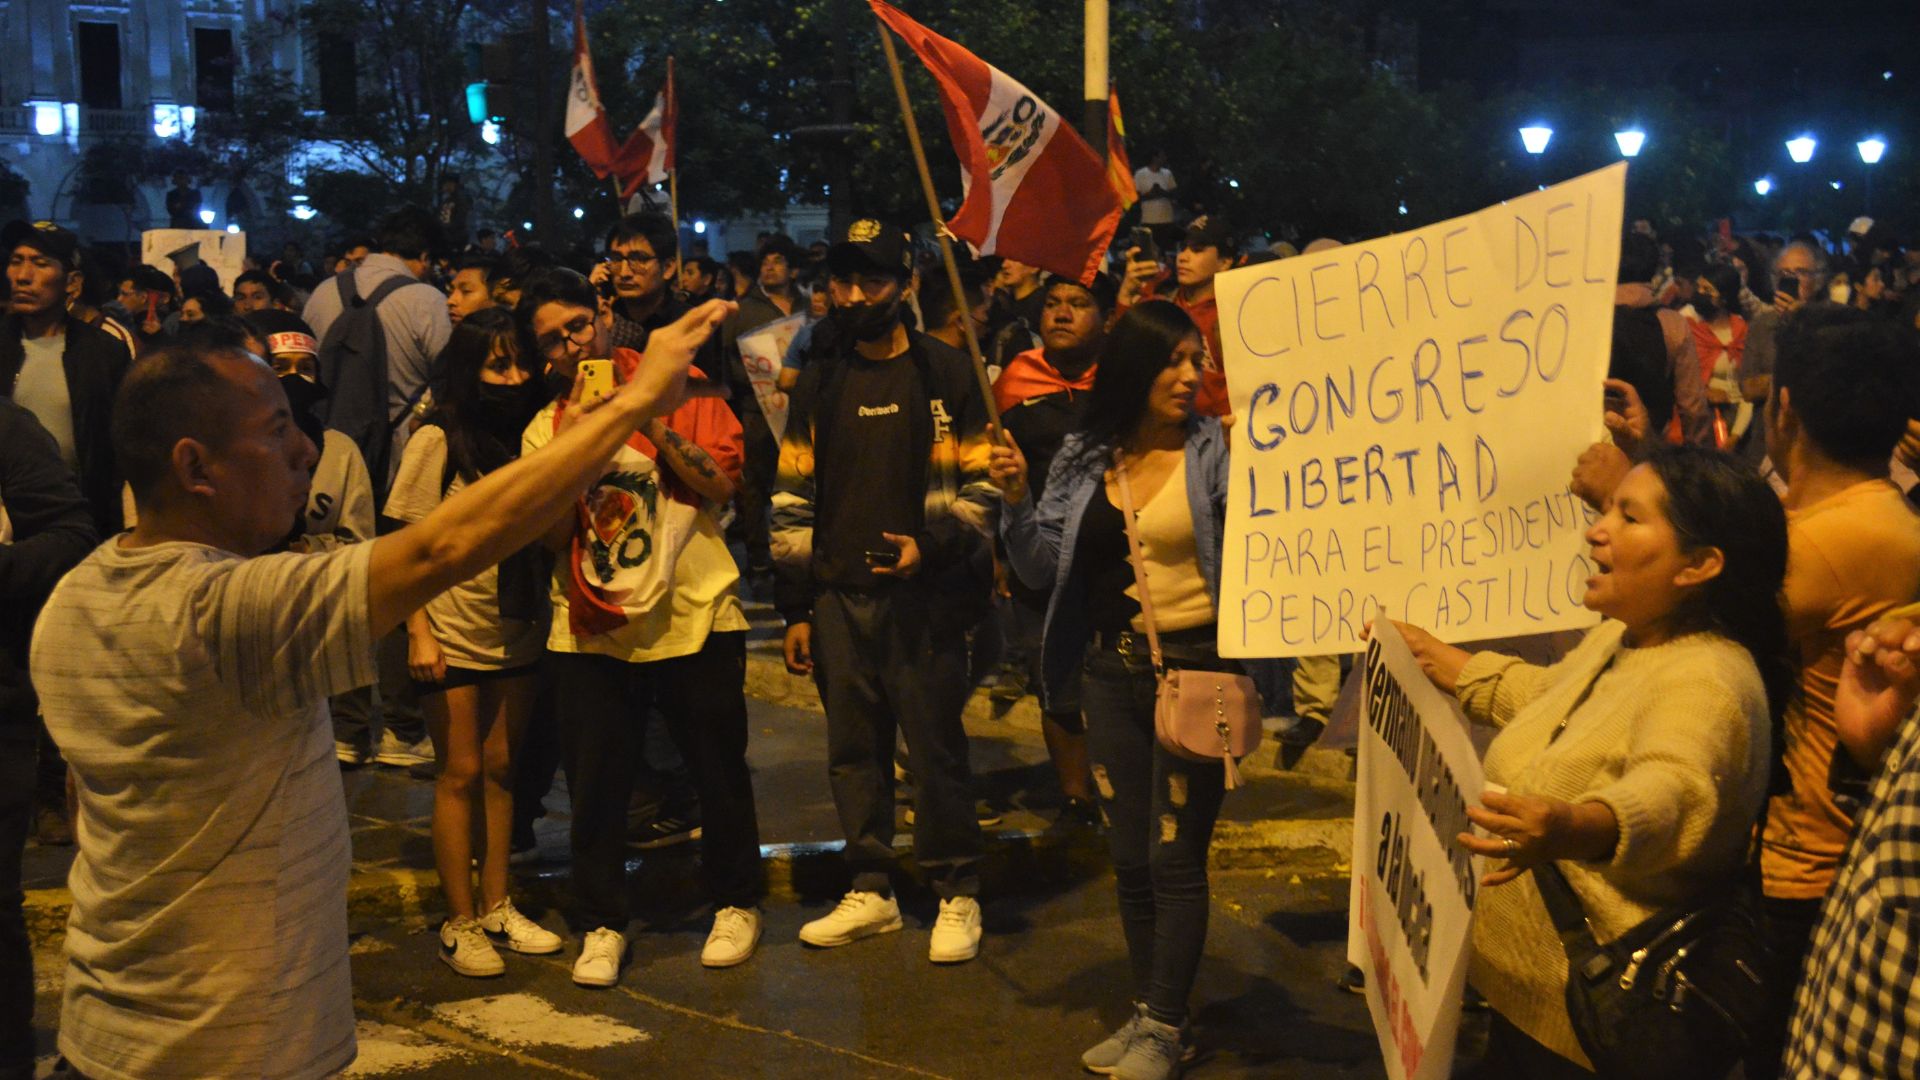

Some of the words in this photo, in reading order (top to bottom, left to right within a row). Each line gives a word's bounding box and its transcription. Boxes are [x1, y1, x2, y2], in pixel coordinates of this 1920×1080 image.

[1238, 227, 1472, 357] CIERRE
[1514, 192, 1606, 293] DEL
[1249, 435, 1498, 518] LIBERTAD
[1244, 527, 1347, 585] PARA
[1364, 525, 1403, 573] EL
[1405, 552, 1591, 631] CASTILLO
